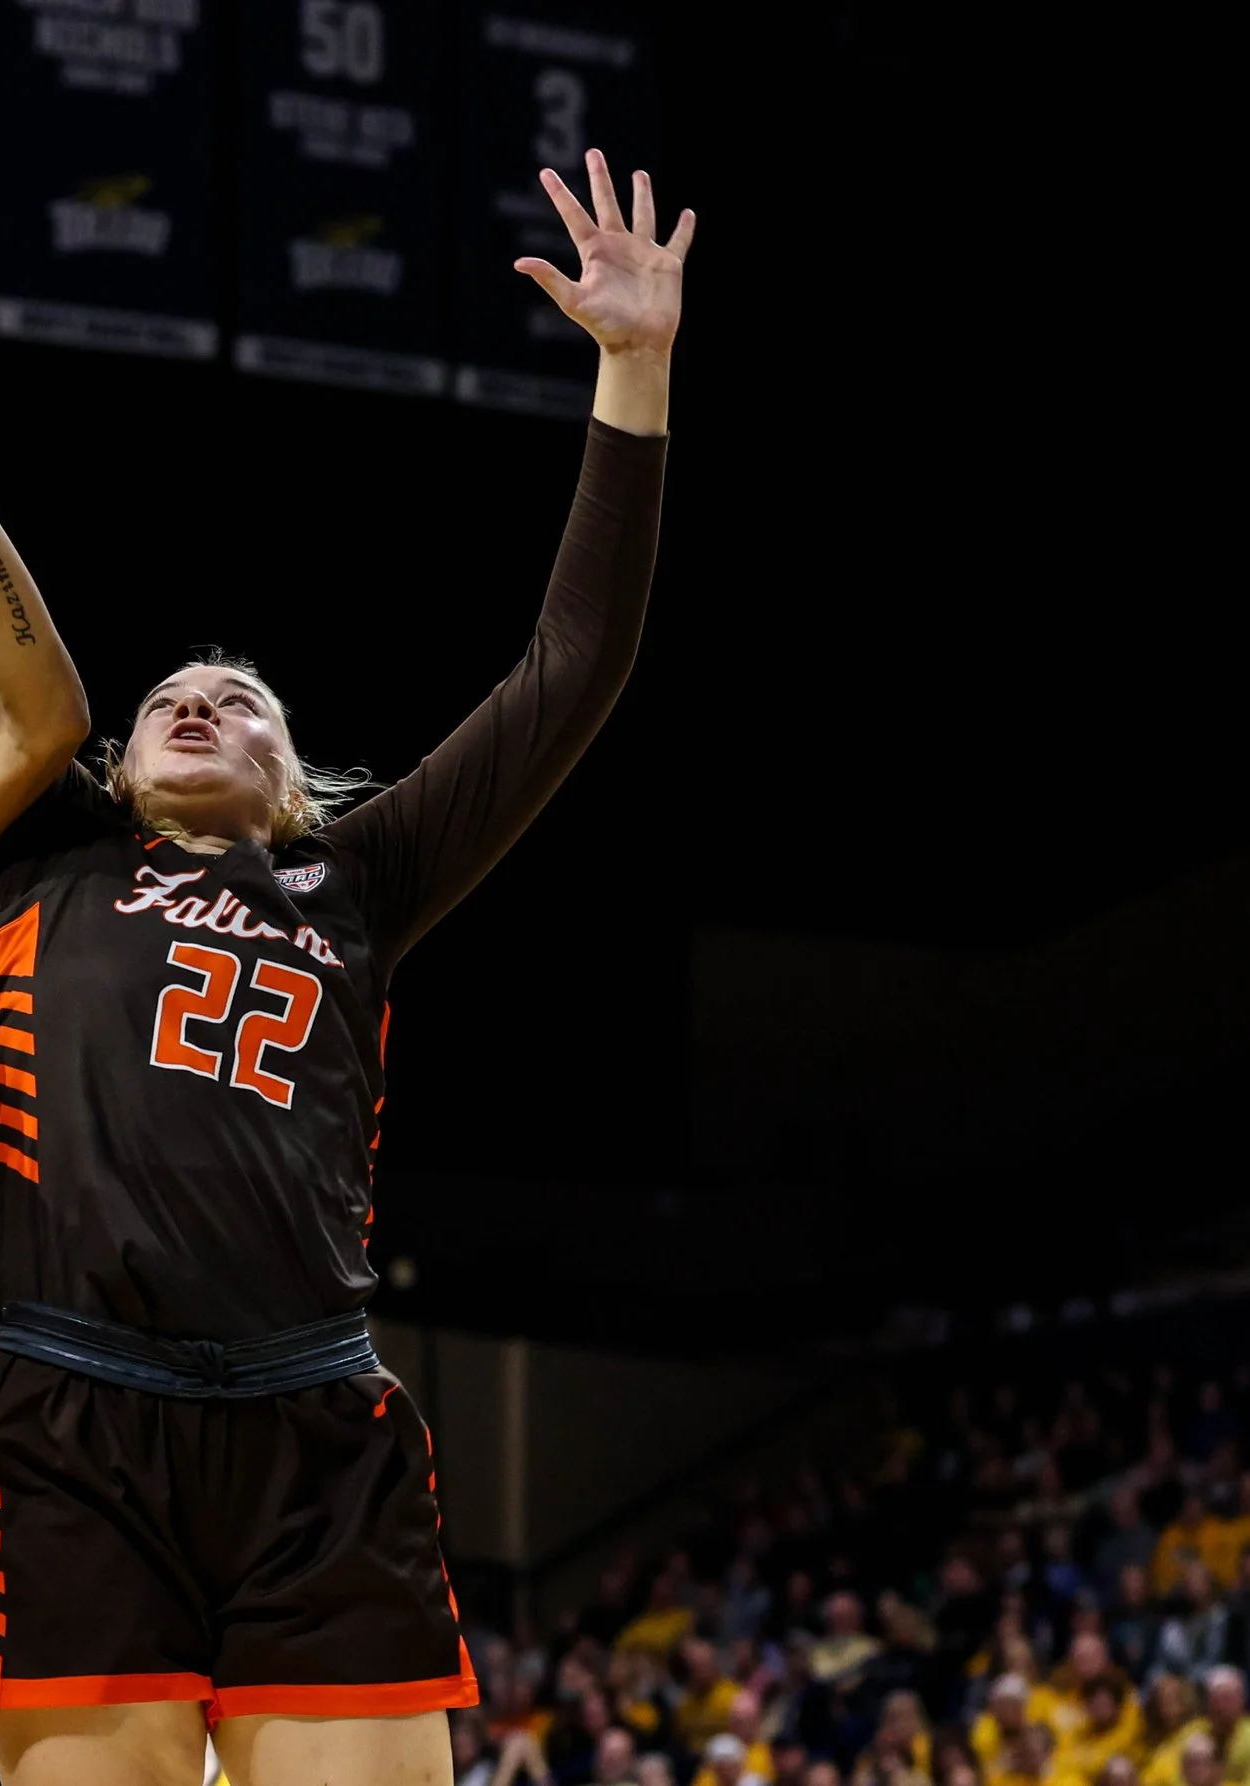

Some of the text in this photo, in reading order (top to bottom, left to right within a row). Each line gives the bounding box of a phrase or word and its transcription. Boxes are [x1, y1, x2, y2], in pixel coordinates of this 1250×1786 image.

[300, 1, 387, 85] 50
[531, 67, 587, 170] 3
[114, 865, 344, 969] Falcn
[150, 941, 323, 1110] 22
